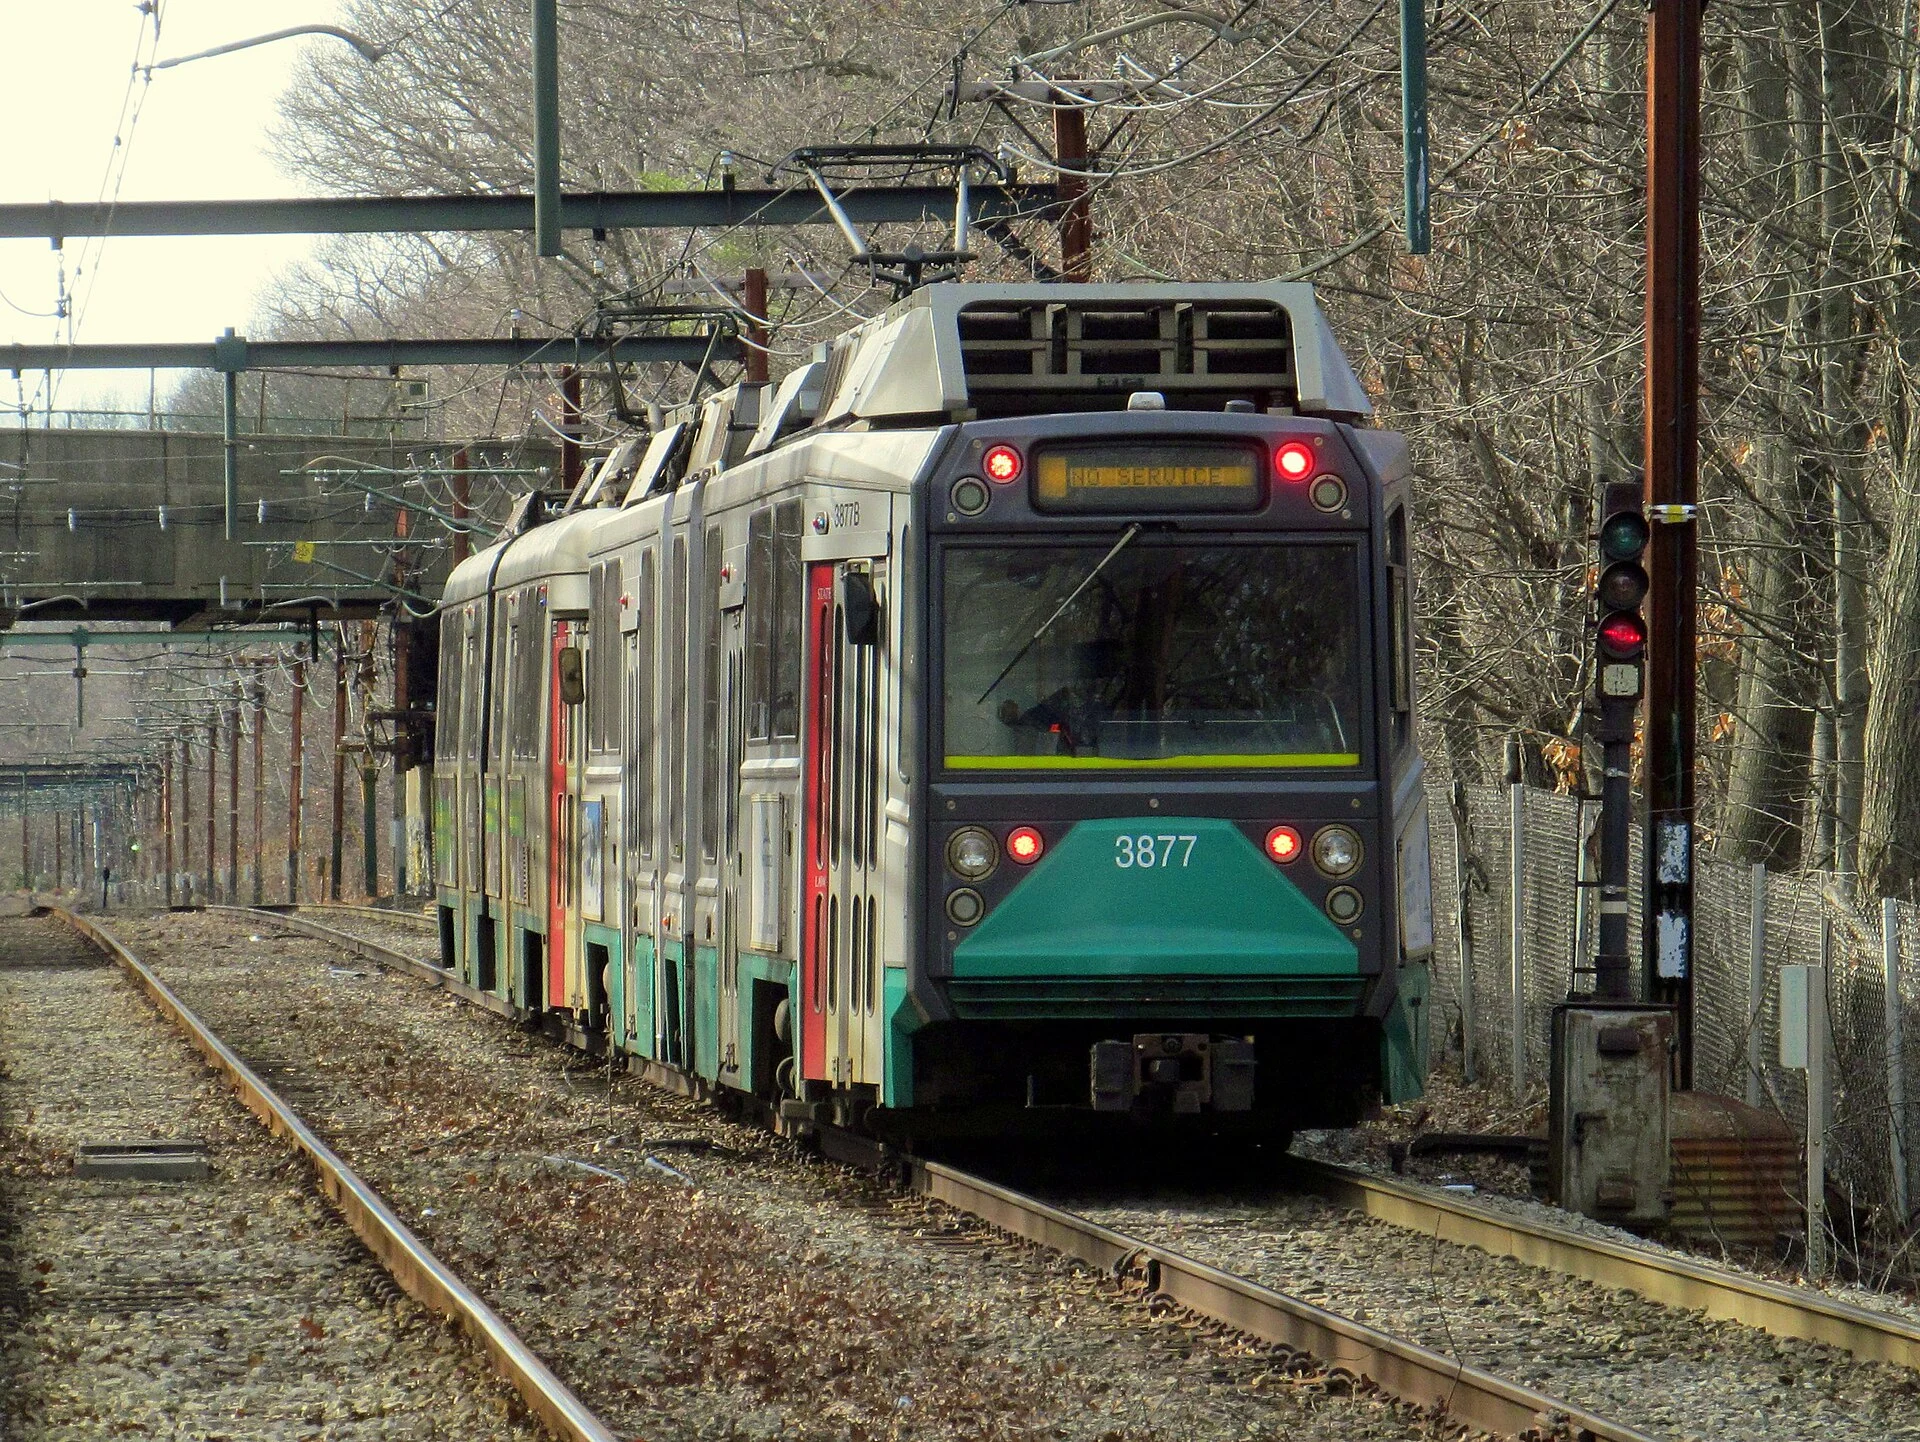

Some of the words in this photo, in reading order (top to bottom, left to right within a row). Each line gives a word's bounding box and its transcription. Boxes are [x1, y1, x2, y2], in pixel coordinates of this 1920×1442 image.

[1072, 467, 1100, 486] NO
[1117, 467, 1222, 486] SERVICE
[834, 501, 860, 528] 3877B
[1115, 834, 1198, 869] 3877
